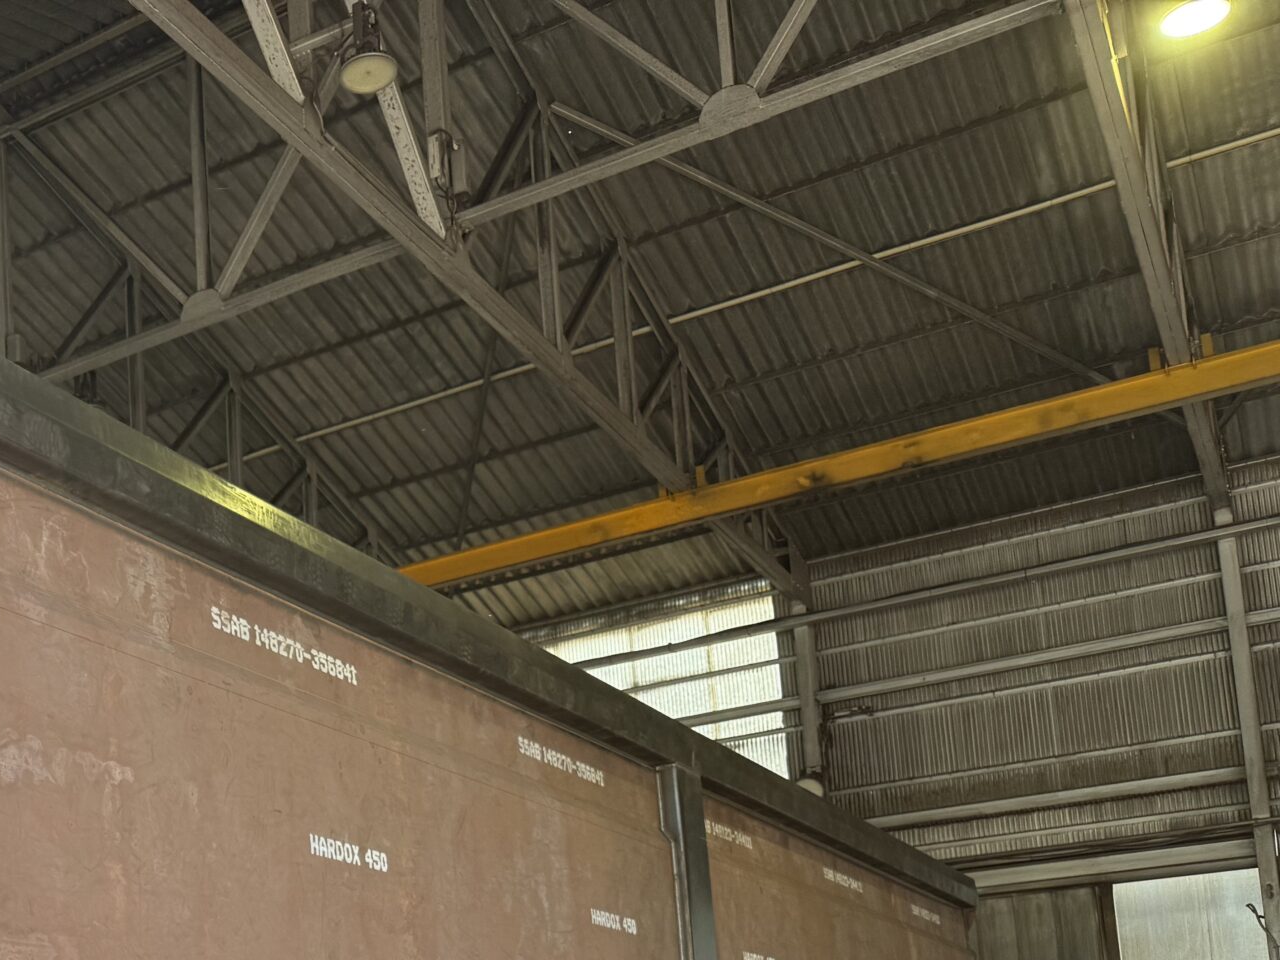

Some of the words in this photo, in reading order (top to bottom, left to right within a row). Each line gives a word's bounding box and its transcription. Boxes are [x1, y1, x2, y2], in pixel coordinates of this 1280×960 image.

[211, 606, 251, 642] SSAB
[254, 624, 357, 686] 148270-356841
[518, 736, 542, 761] SSAB
[310, 833, 361, 867] HARDOX
[364, 848, 388, 873] 450
[591, 907, 621, 931] HARDOX
[623, 917, 637, 935] 450
